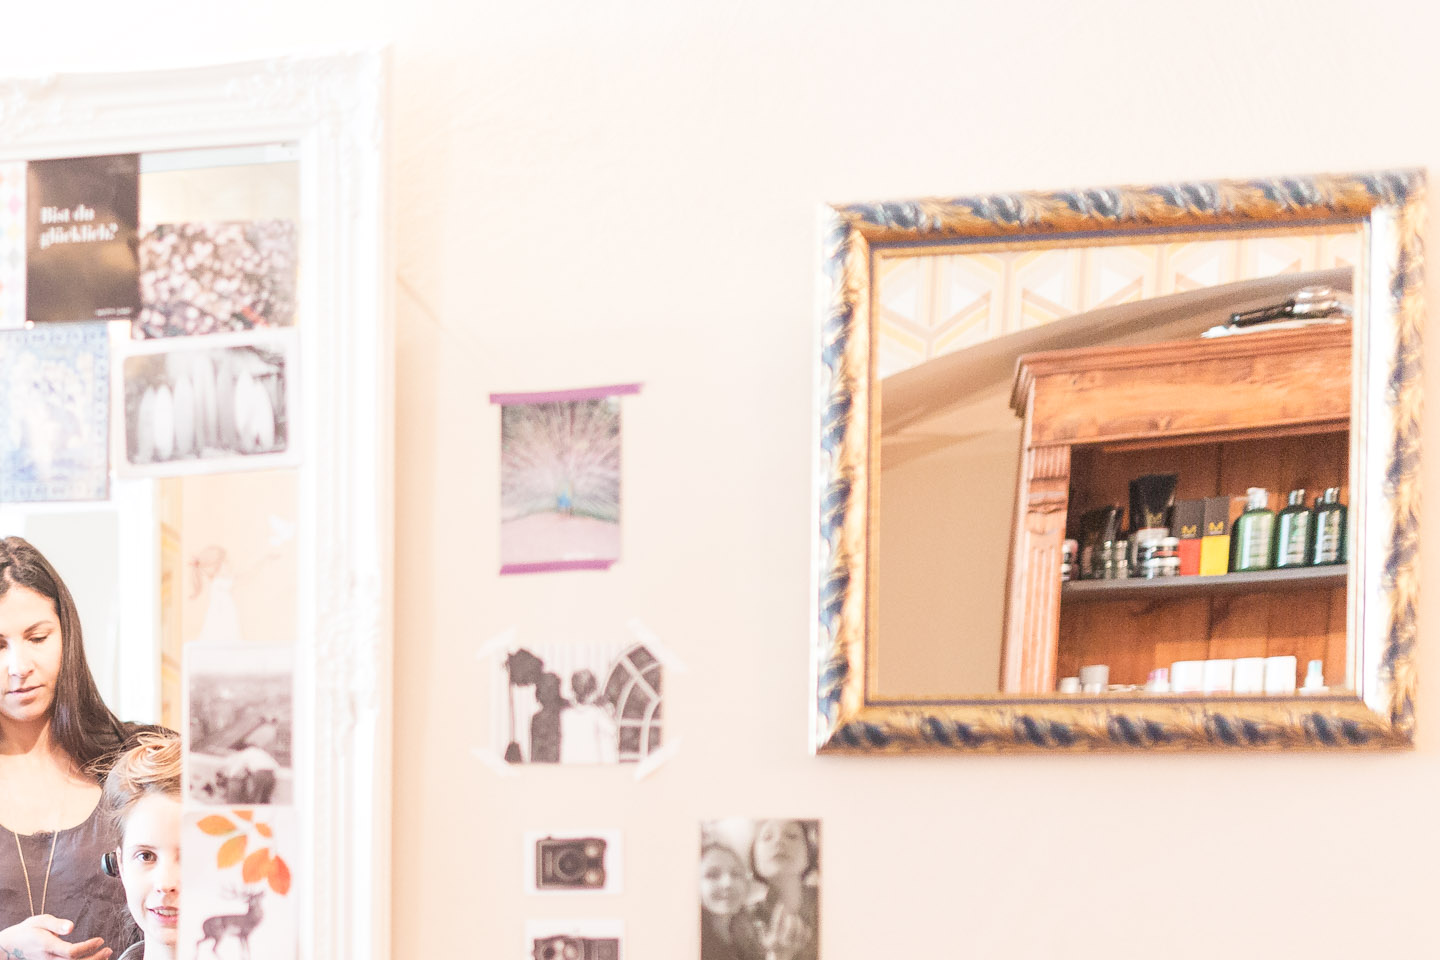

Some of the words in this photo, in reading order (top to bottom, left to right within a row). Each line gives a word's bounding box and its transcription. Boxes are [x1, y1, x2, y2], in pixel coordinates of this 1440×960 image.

[40, 206, 70, 224] Bist
[73, 203, 96, 222] du
[40, 222, 119, 250] glücklich?
